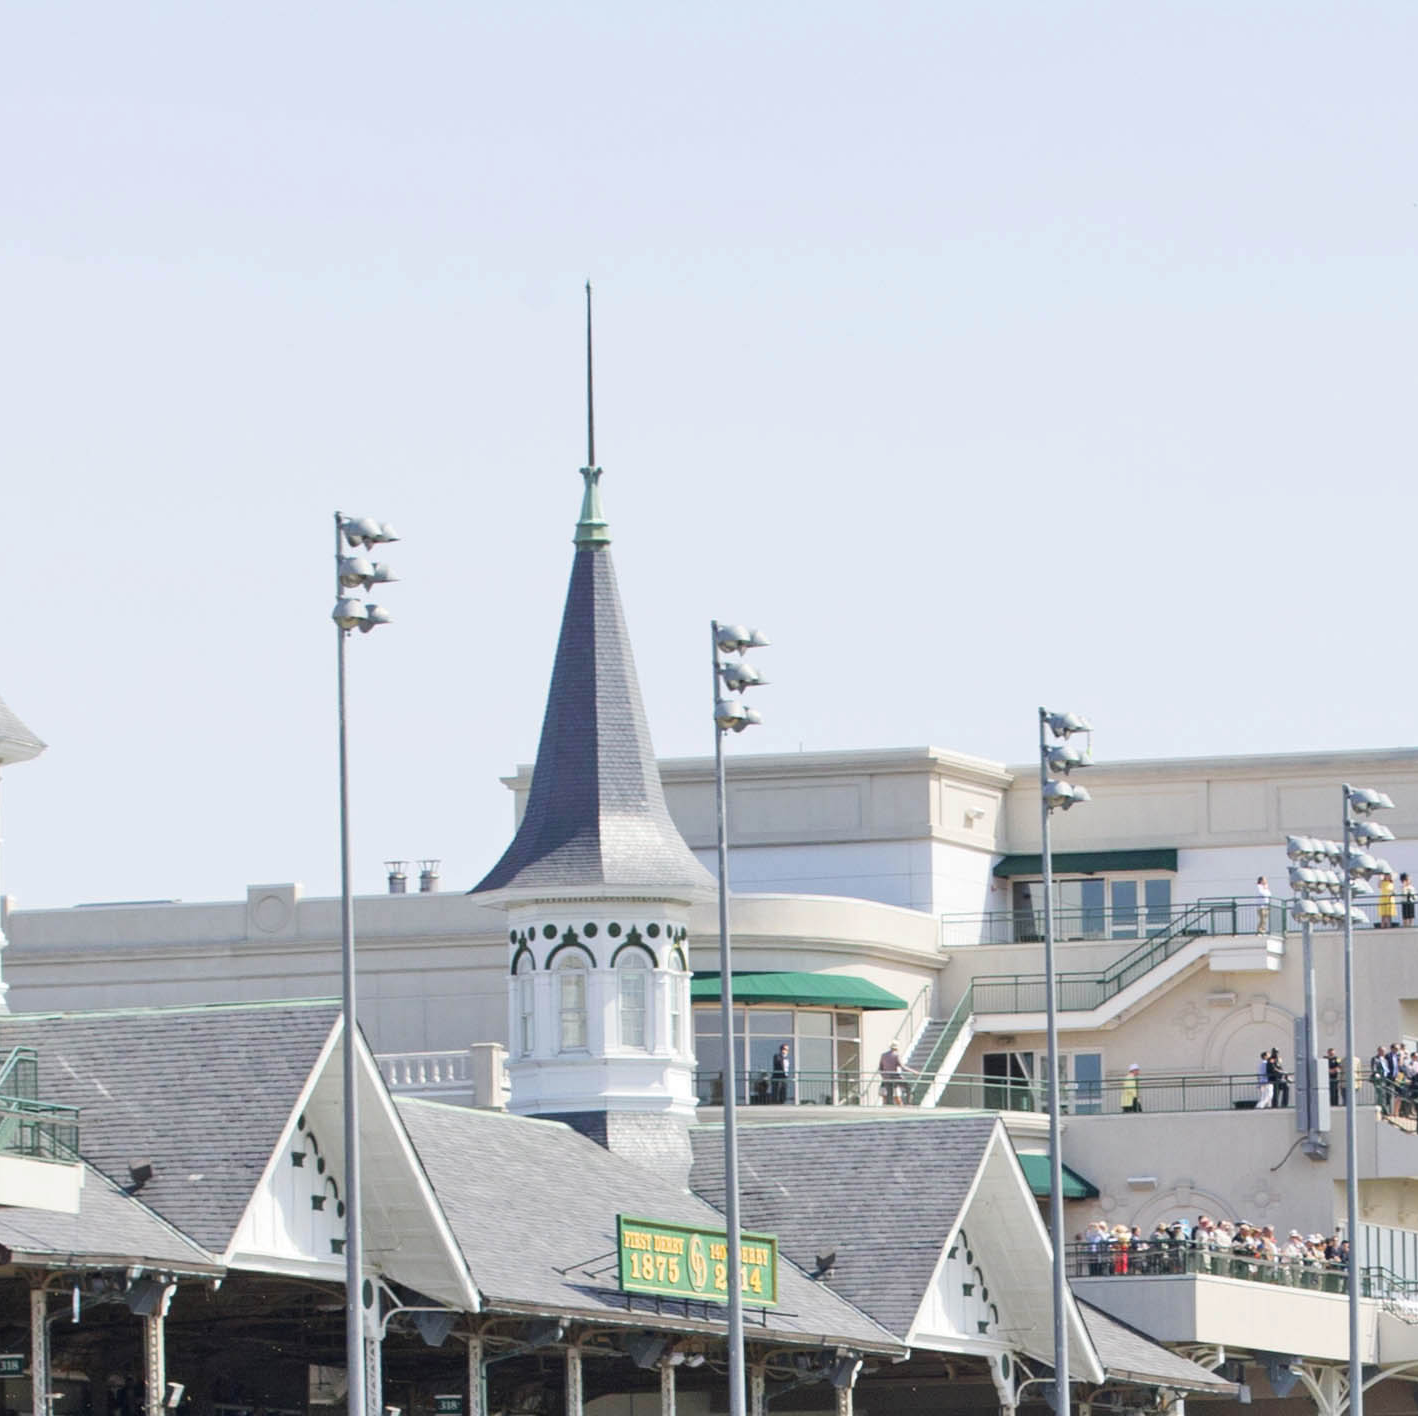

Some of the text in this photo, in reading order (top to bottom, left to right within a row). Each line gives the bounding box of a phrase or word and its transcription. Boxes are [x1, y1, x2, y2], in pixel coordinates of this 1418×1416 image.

[624, 1231, 684, 1254] FIRST DERBY
[741, 1246, 769, 1266] ERBY
[630, 1253, 680, 1284] 1875
[715, 1263, 763, 1294] 214
